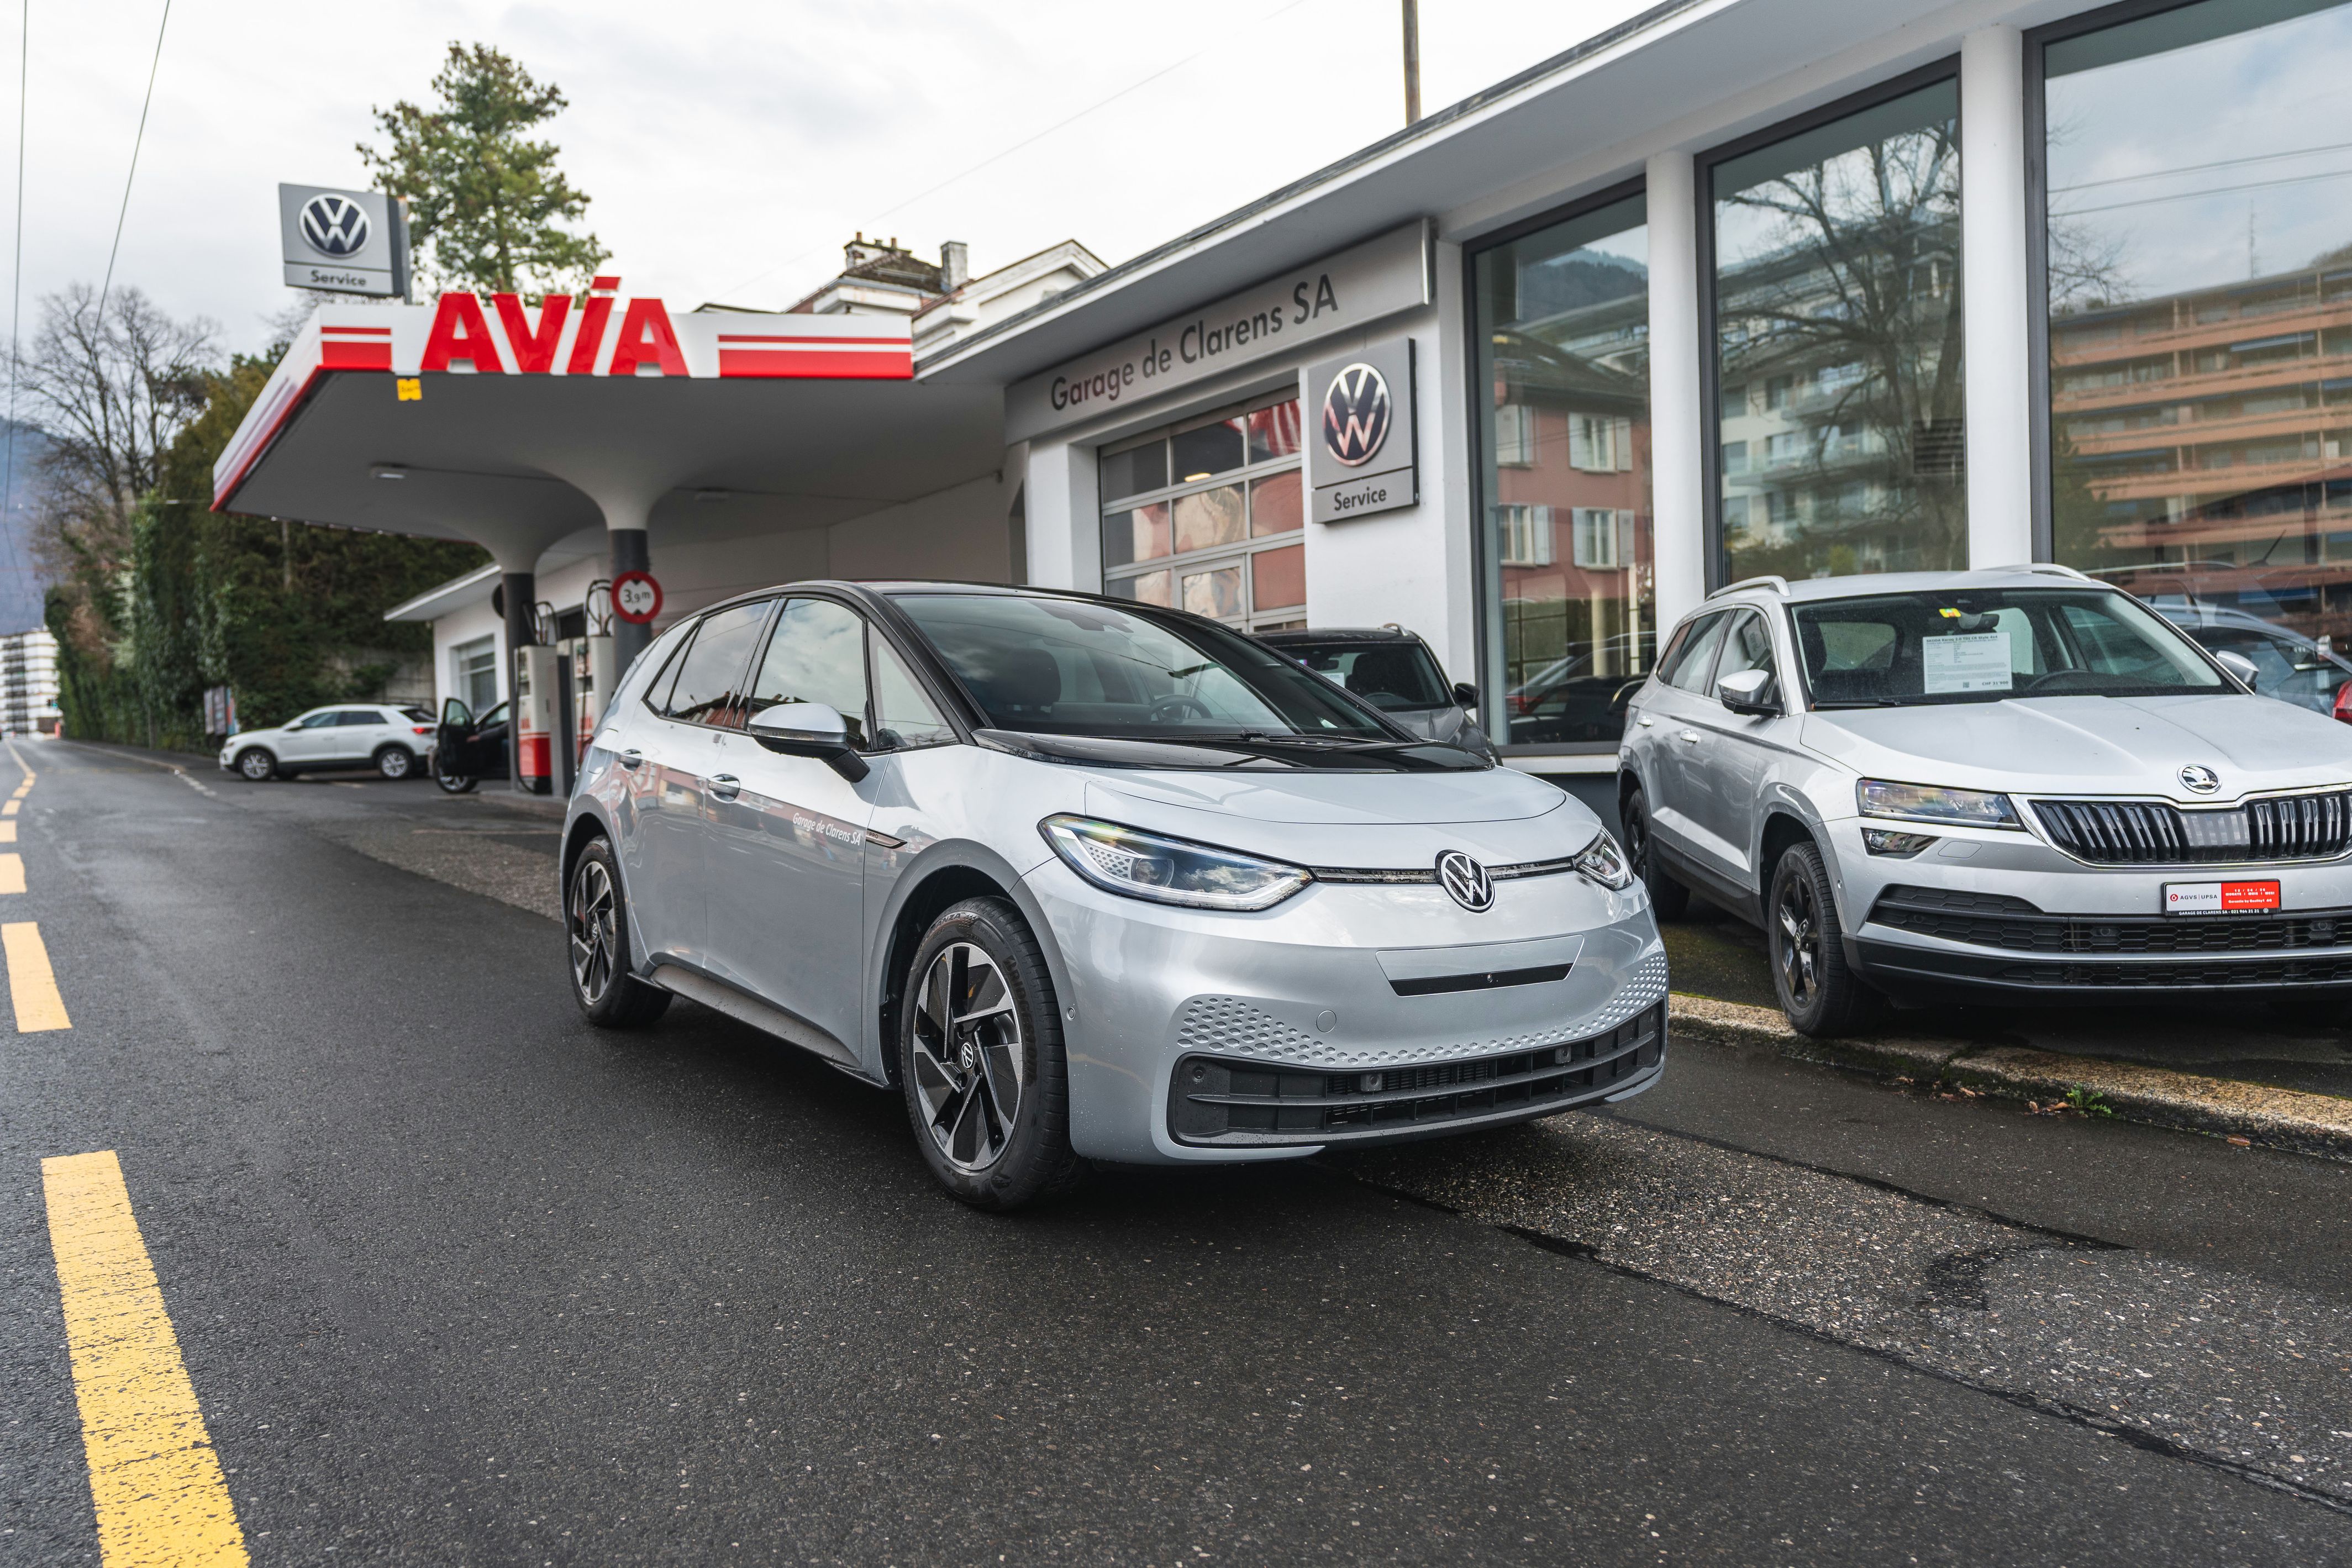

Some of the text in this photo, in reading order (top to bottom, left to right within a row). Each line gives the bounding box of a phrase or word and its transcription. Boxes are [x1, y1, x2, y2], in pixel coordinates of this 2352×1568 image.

[311, 269, 366, 286] Service
[1051, 273, 1339, 411] Garage de Clarens SA
[1334, 486, 1387, 512] Service
[793, 812, 861, 846] Garage de Clarens SA
